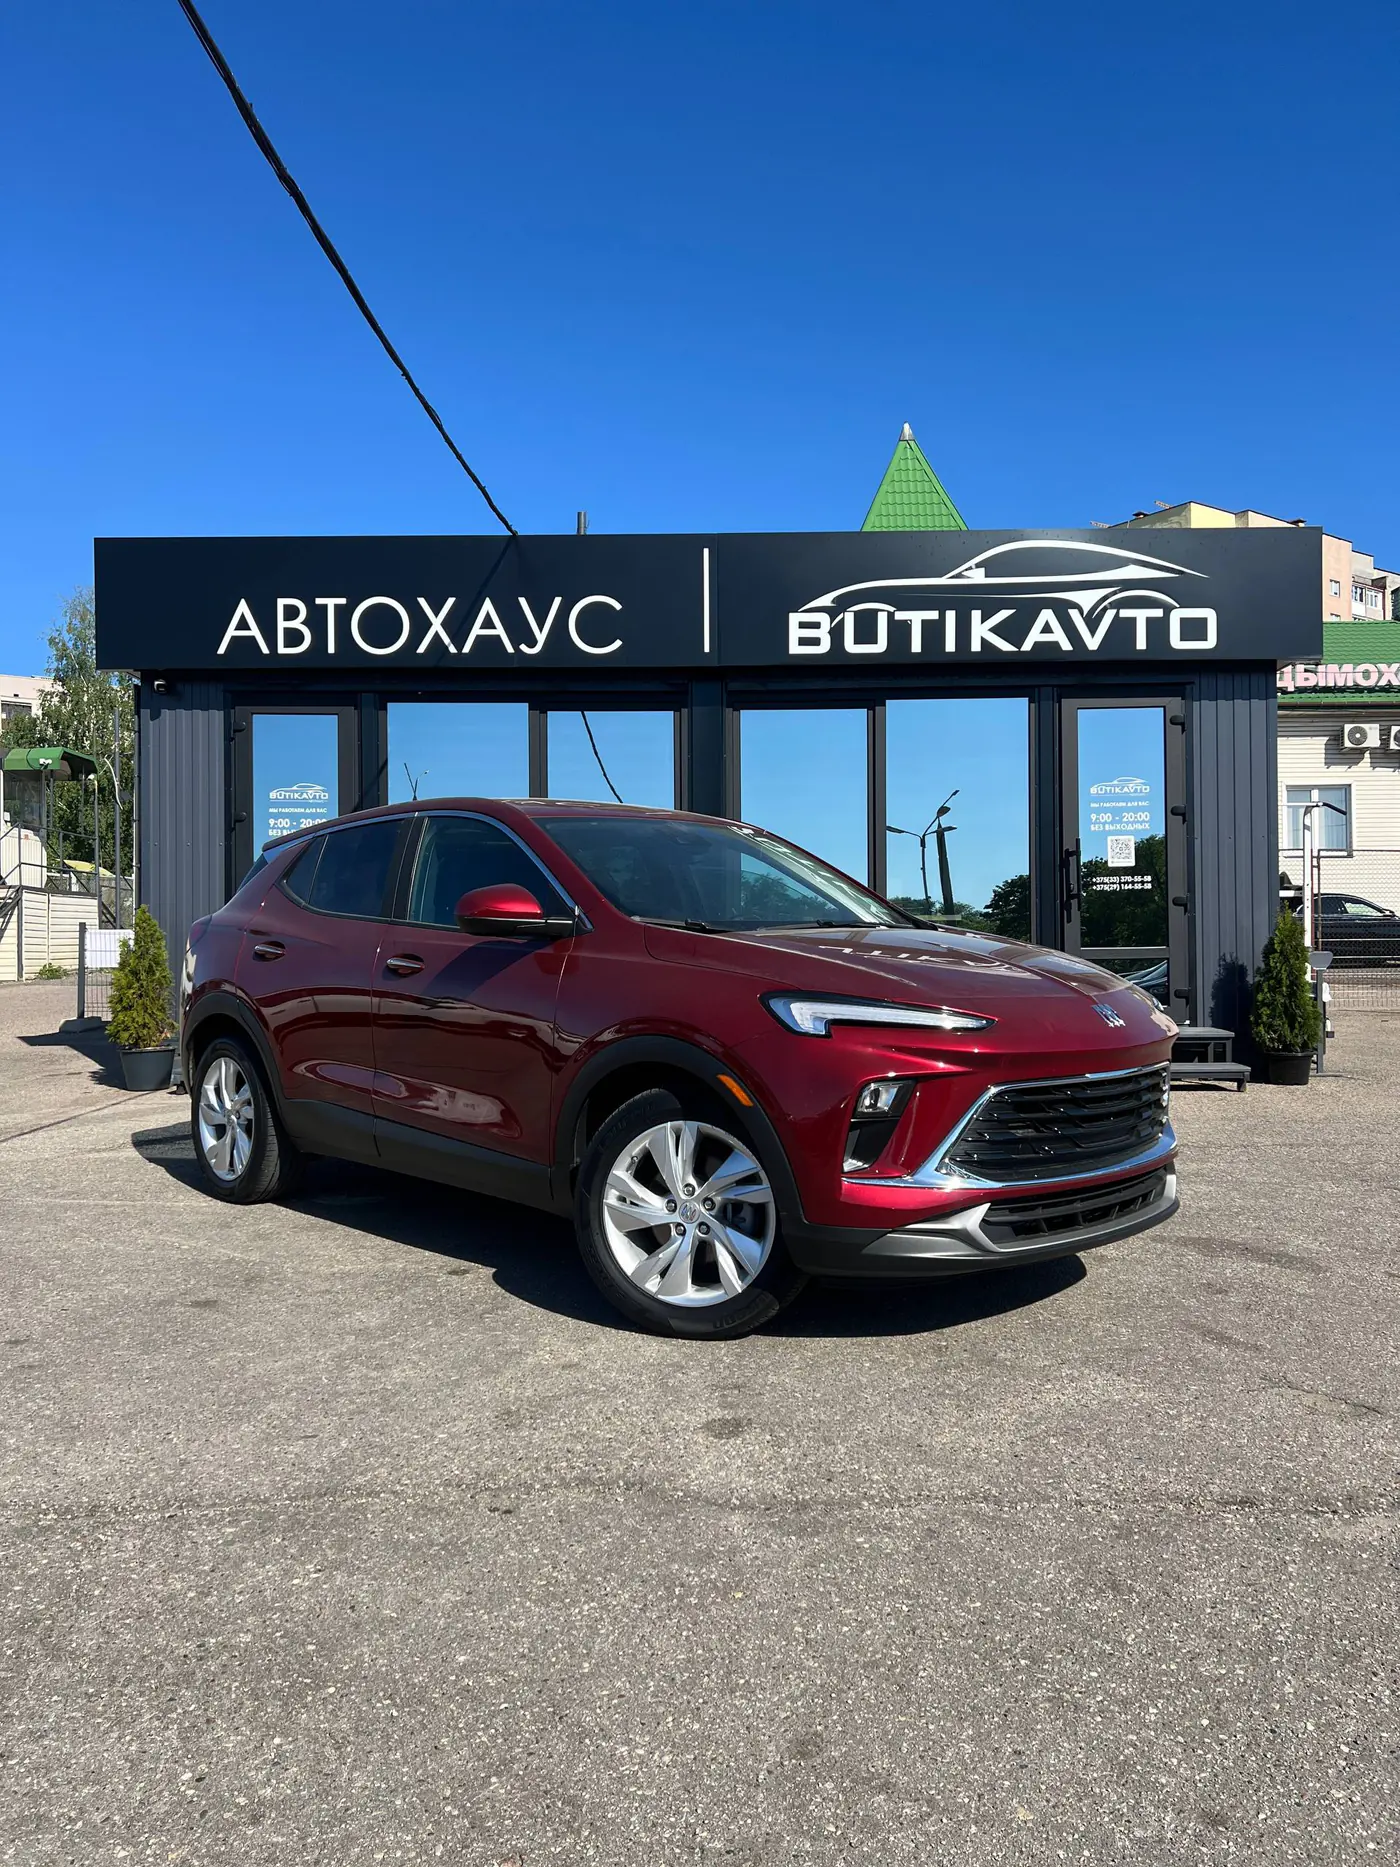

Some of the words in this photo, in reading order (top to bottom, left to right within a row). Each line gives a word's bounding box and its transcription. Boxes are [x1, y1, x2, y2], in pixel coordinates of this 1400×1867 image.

[217, 595, 623, 655] АВТОХАУС
[788, 606, 1218, 654] BUTIKAVTO
[1277, 663, 1400, 692] ДЫМОХ
[1090, 786, 1150, 794] BUTIKAVTO
[269, 819, 290, 827] 9:00
[1090, 814, 1112, 822] 9:00
[1122, 812, 1150, 821] 20:00
